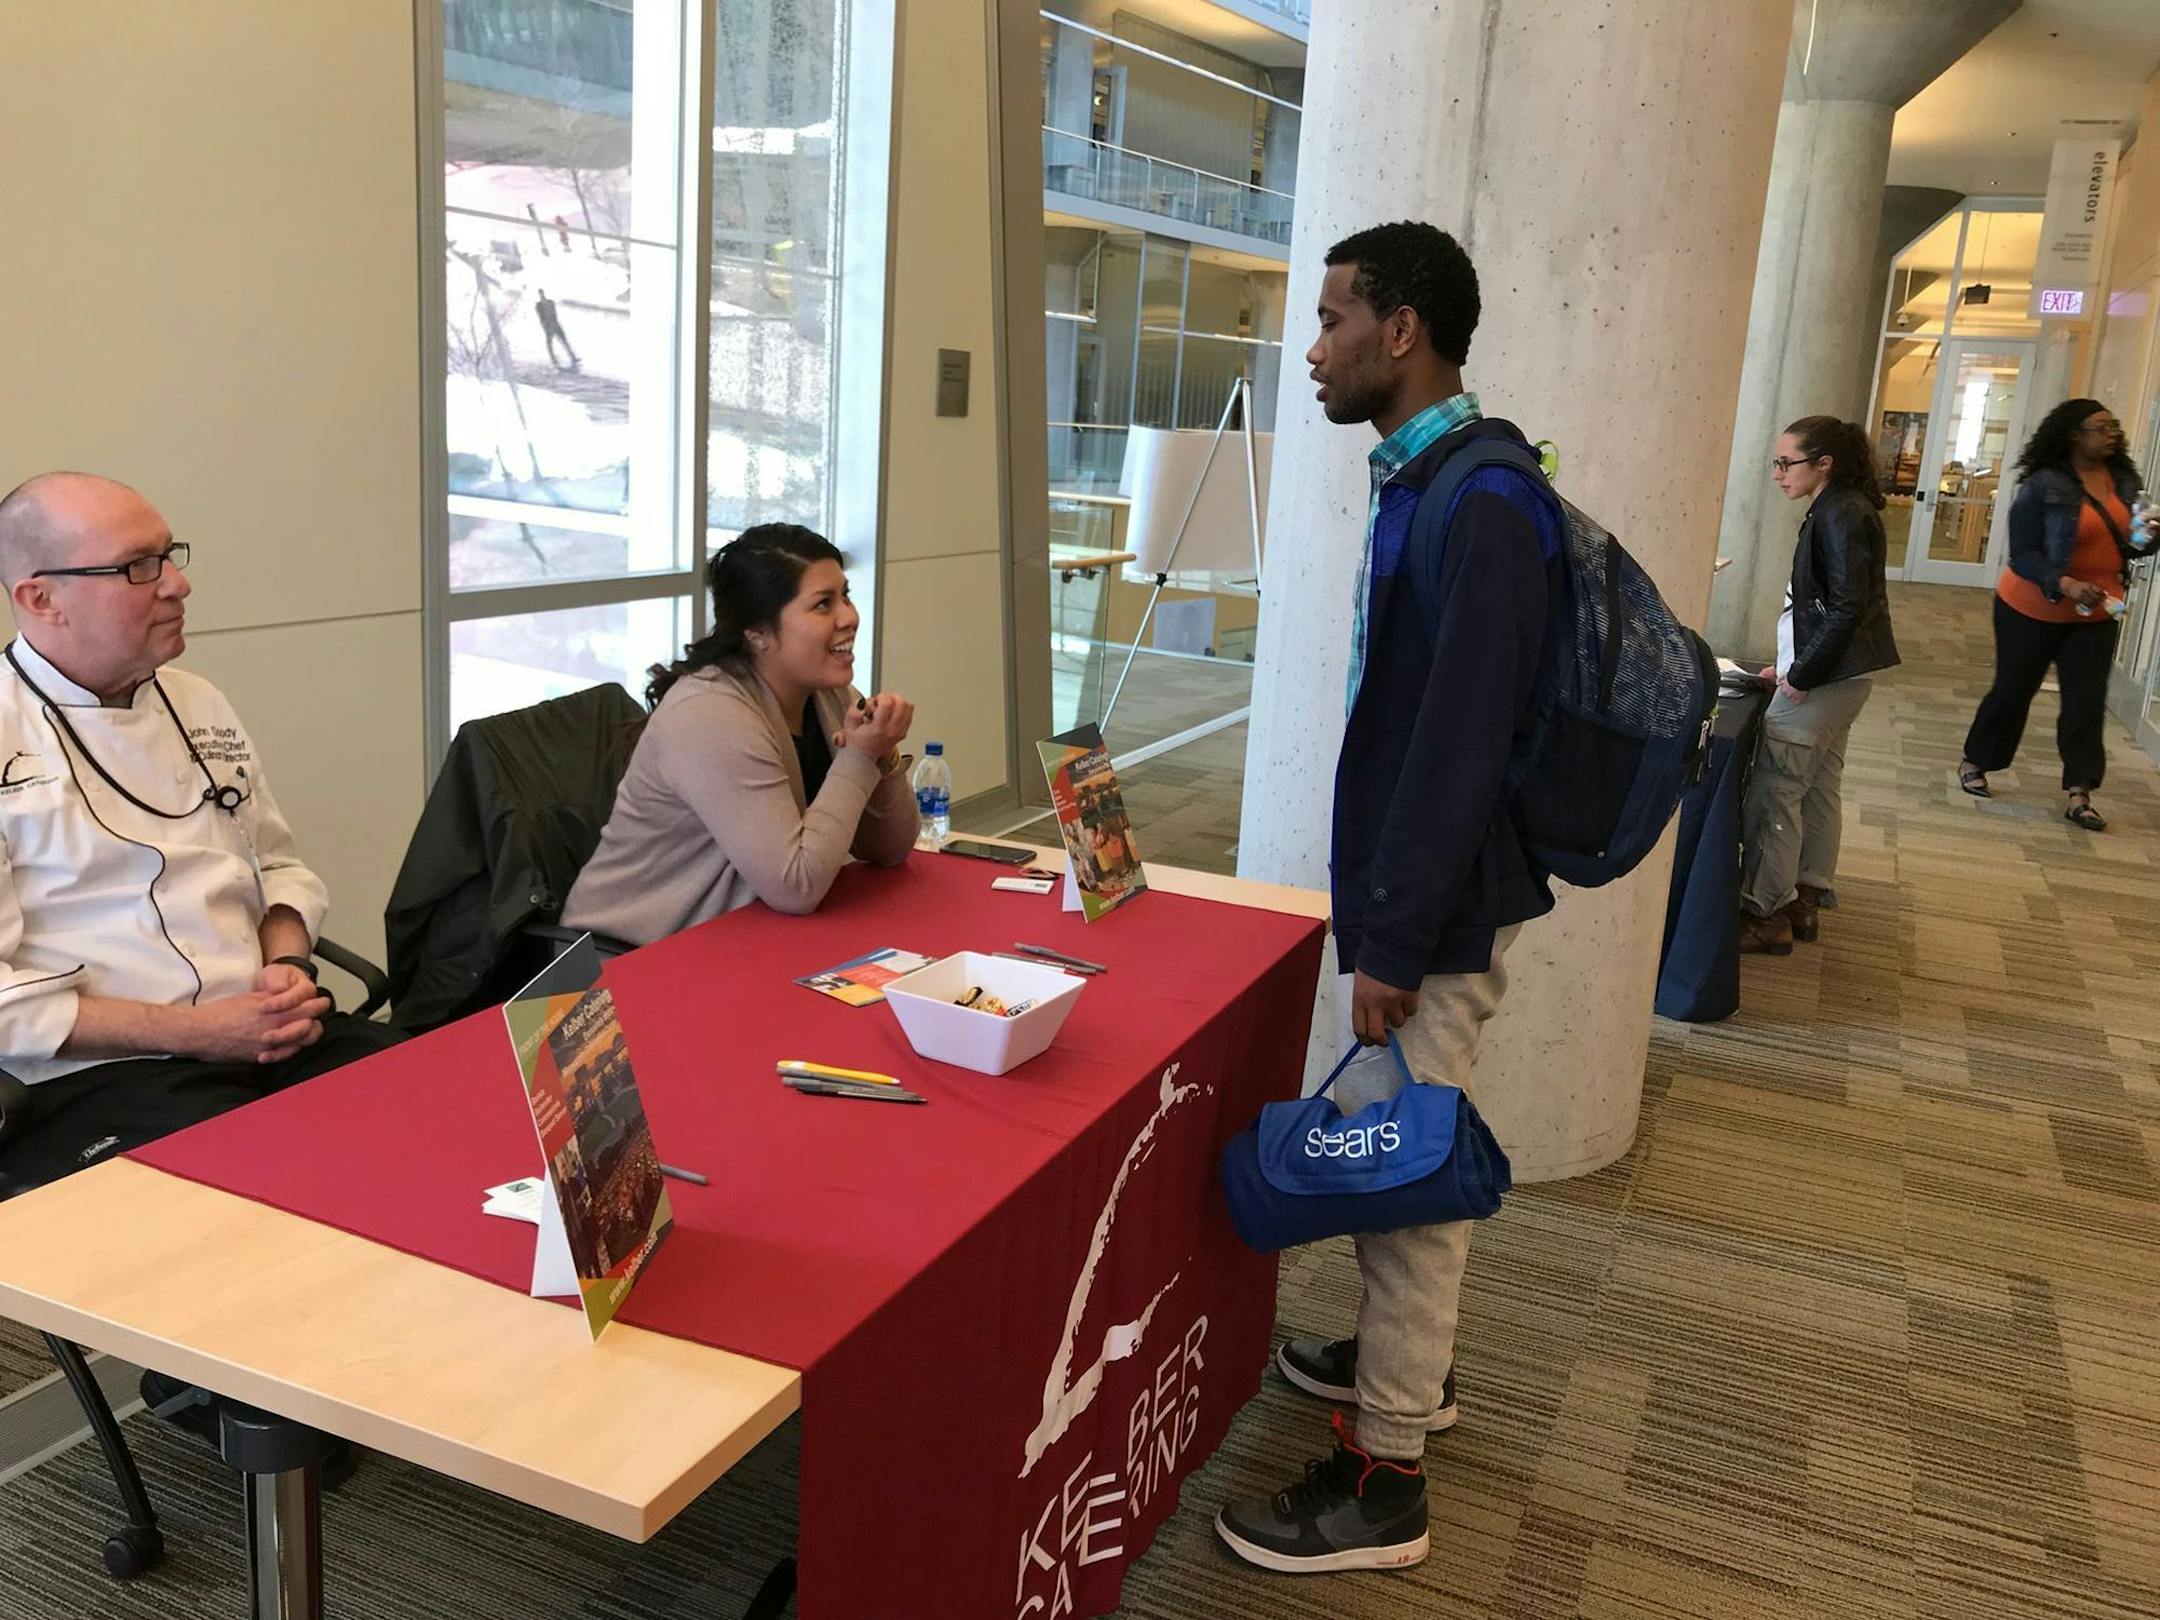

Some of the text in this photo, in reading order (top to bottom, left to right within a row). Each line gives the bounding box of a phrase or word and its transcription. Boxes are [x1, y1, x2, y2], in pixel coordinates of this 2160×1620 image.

[2084, 151, 2108, 223] elevators
[2043, 292, 2075, 311] EXIT
[1304, 1121, 1400, 1158] sears
